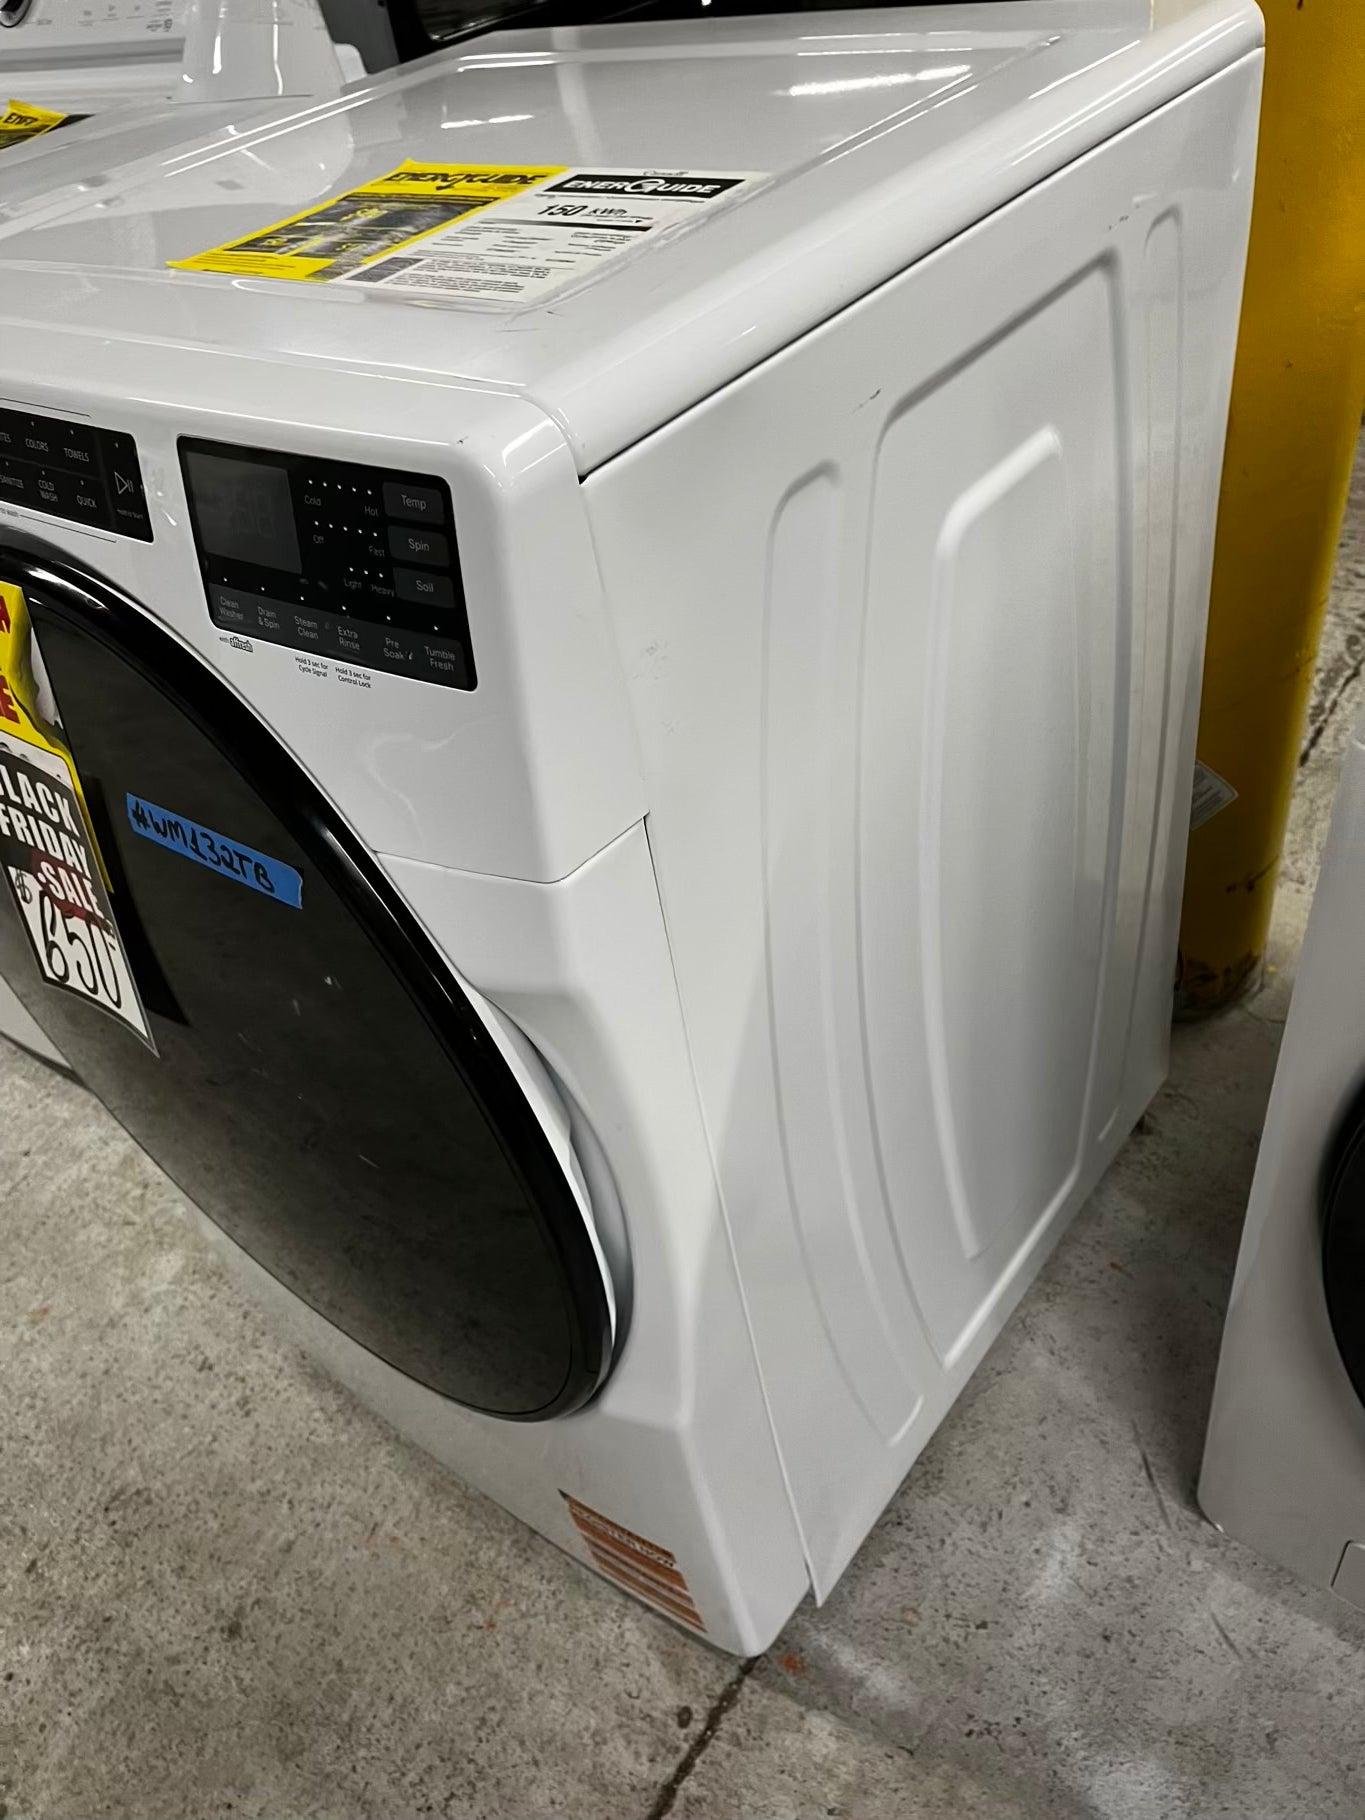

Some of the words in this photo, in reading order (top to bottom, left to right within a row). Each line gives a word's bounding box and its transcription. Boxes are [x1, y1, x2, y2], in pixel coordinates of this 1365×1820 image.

[562, 178, 722, 194] ENERGUIDE
[537, 204, 588, 217] 150
[25, 438, 49, 452] COLORS
[63, 447, 90, 462] TOWELS
[76, 495, 97, 508] QUICK
[304, 495, 321, 507] Cold
[364, 506, 379, 517] Hot
[401, 495, 427, 511] Temp
[408, 538, 430, 553] Spin
[416, 580, 434, 592] Soil
[219, 596, 239, 609] Clean
[257, 606, 277, 619] Drain
[264, 618, 280, 630] Spin
[294, 615, 318, 630] Steam
[298, 627, 318, 640] Clean
[337, 626, 358, 640] Extra
[339, 637, 360, 650] Rinse
[385, 637, 400, 649] Pre
[383, 648, 405, 660] Soak
[424, 645, 456, 661] Tumble
[295, 656, 307, 665] Hold
[312, 661, 320, 669] sec
[320, 662, 329, 670] for
[430, 658, 454, 671] Fresh
[298, 664, 312, 674] Cycle
[312, 667, 328, 678] Signal
[335, 666, 348, 676] Hold
[353, 671, 362, 679] sec
[362, 673, 371, 681] for
[338, 674, 358, 687] Control
[358, 680, 372, 689] Lock
[40, 860, 105, 920] SALE
